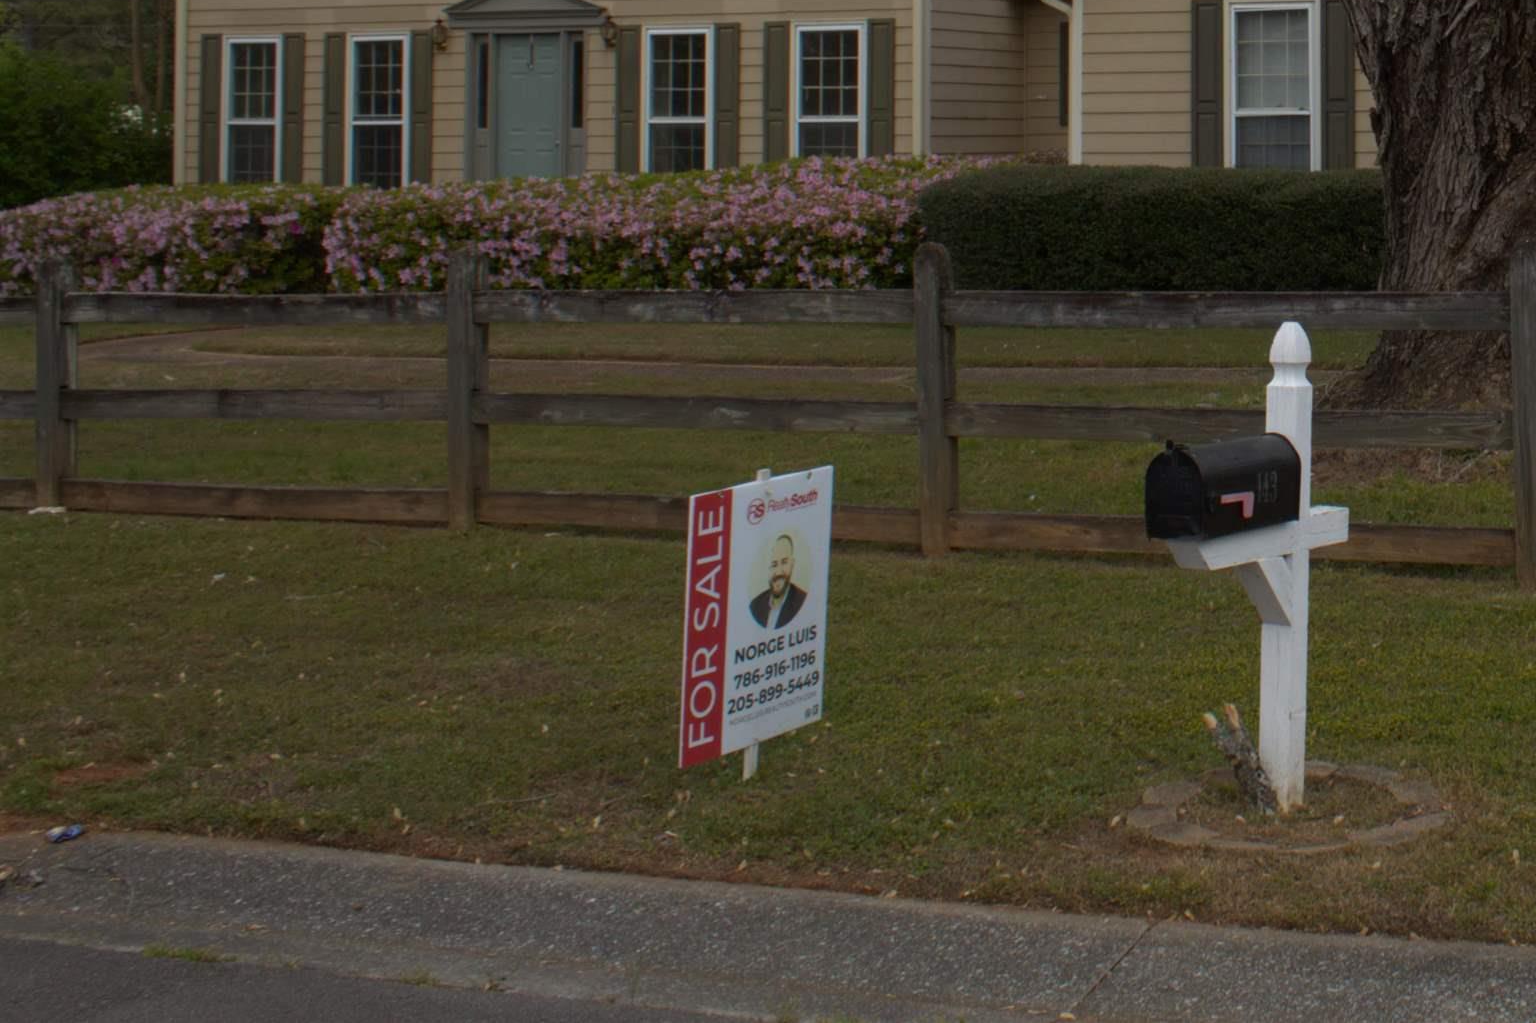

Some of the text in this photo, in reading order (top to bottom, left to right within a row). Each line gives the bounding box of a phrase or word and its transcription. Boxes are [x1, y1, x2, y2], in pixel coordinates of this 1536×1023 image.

[688, 506, 725, 749] FOR SALE
[734, 625, 817, 665] NORGE LUIS
[733, 650, 816, 690] 786-916-1196
[727, 670, 820, 715] 205-899-5449
